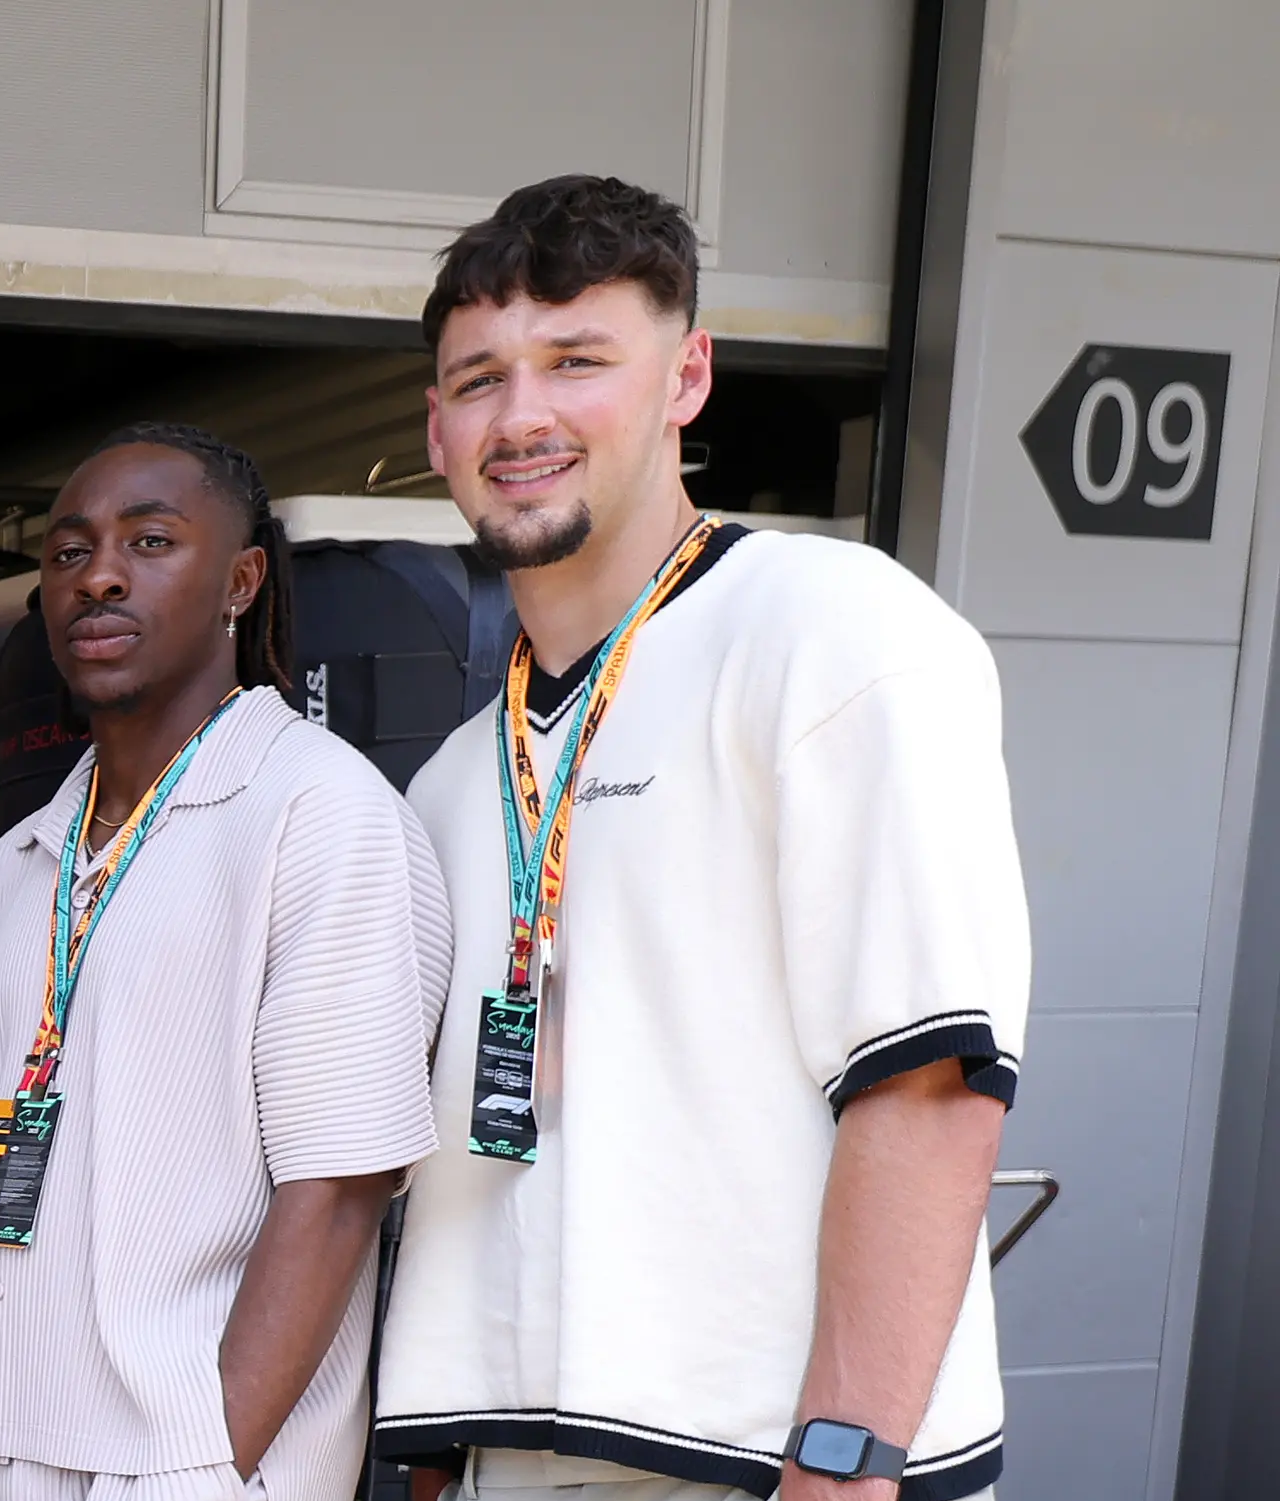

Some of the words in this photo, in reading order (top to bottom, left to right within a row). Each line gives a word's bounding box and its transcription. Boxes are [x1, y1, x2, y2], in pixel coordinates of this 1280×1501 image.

[1071, 376, 1210, 508] 09
[487, 1010, 534, 1049] Sunday
[16, 1109, 52, 1140] Sunday
